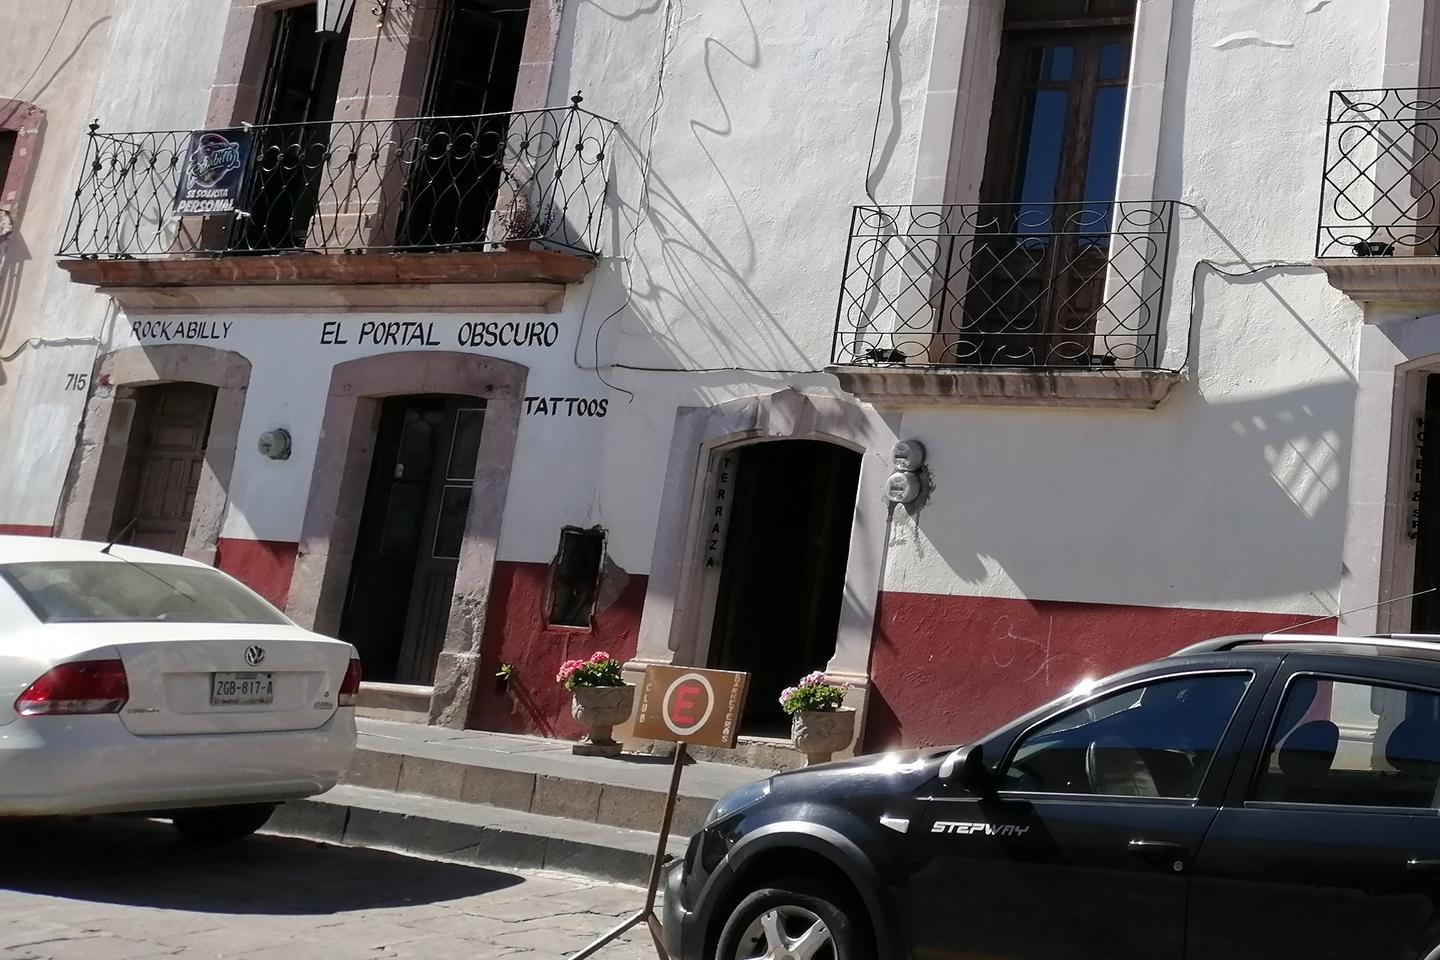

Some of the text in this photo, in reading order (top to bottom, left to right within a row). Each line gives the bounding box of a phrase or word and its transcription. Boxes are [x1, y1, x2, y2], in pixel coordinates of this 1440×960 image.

[196, 188, 228, 198] SOLICITA
[177, 199, 235, 212] PERSONAL
[130, 320, 233, 341] ROCKABILLY
[320, 321, 559, 347] EL PORTAL OBSCURO
[64, 373, 88, 391] 715
[524, 396, 609, 418] TATTOOS
[705, 458, 730, 568] TERRAZA
[216, 680, 273, 696] ZGB-817-A
[639, 683, 653, 724] CLUB
[671, 685, 701, 726] E
[930, 821, 1030, 836] STEPWAY
